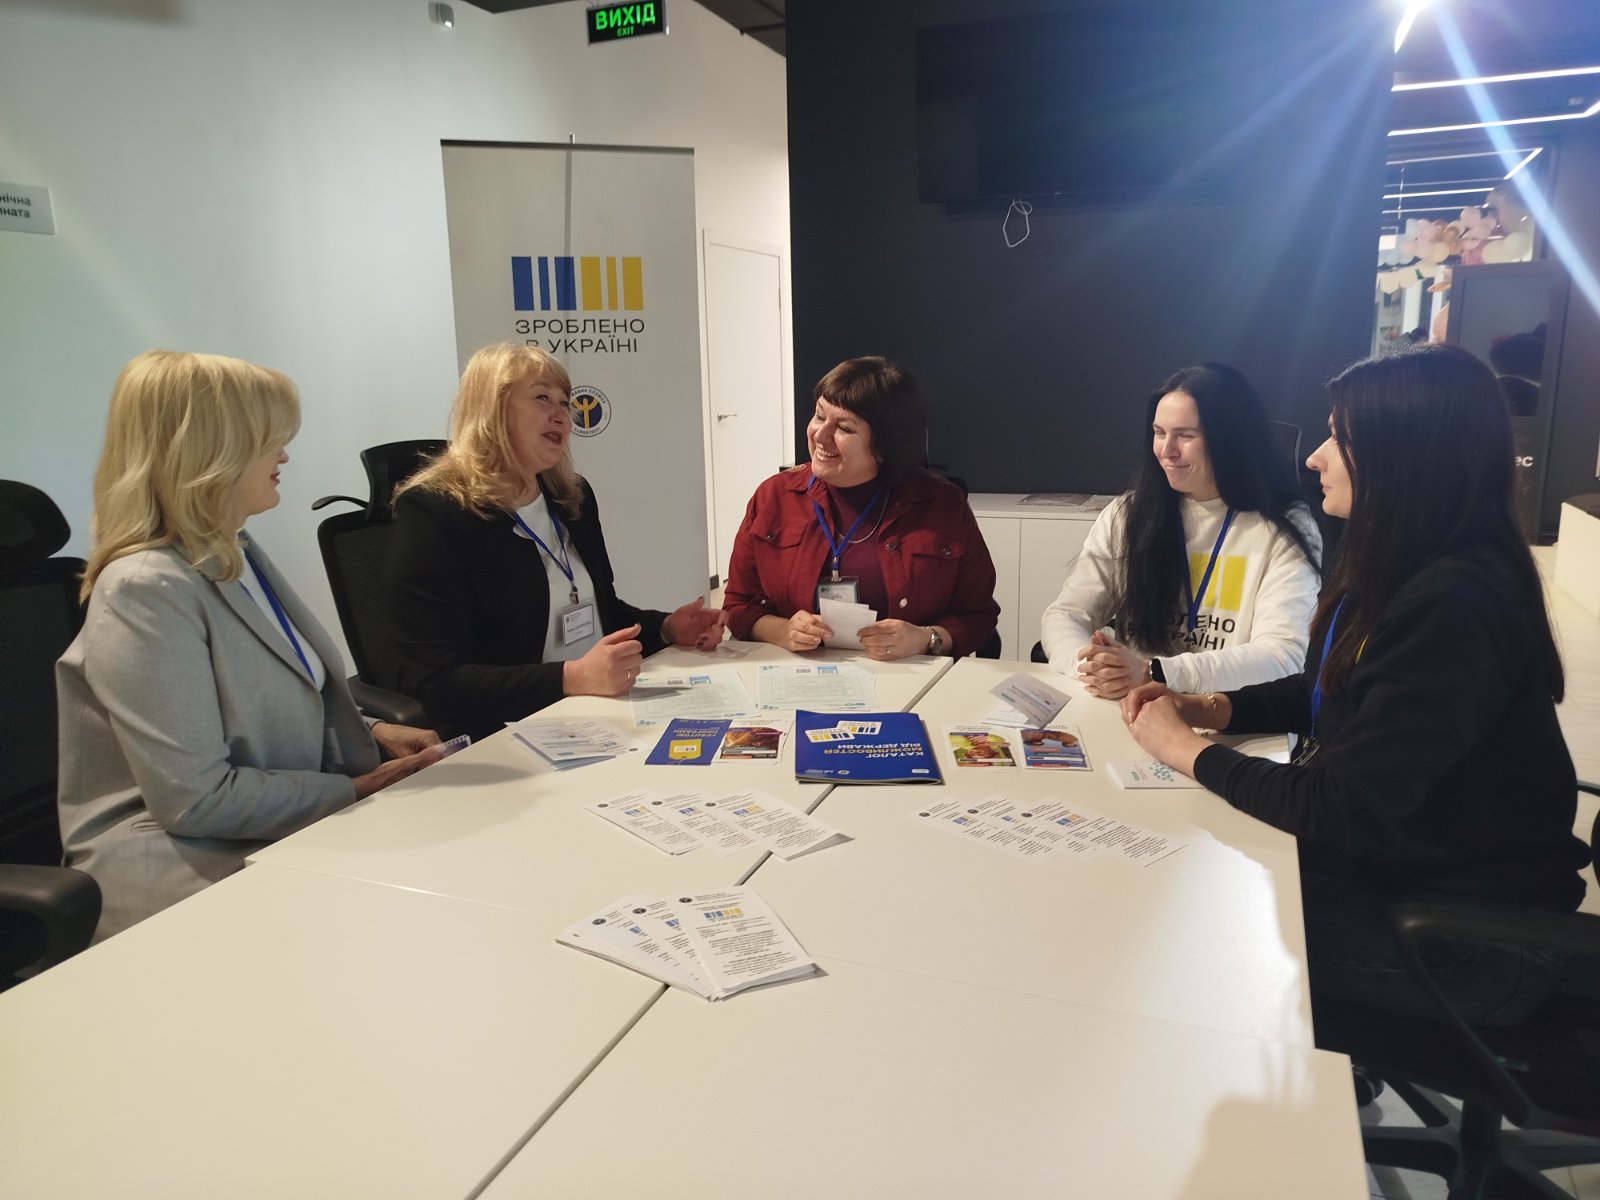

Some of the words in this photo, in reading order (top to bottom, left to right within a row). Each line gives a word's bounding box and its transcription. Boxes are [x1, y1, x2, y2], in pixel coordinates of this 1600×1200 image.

[595, 2, 656, 31] ВИХІД
[616, 26, 635, 37] EXIT
[515, 318, 645, 334] ЗРОБЛЕНО
[547, 334, 638, 354] УКРАЇНІ
[864, 751, 924, 759] КАТАЛОГ
